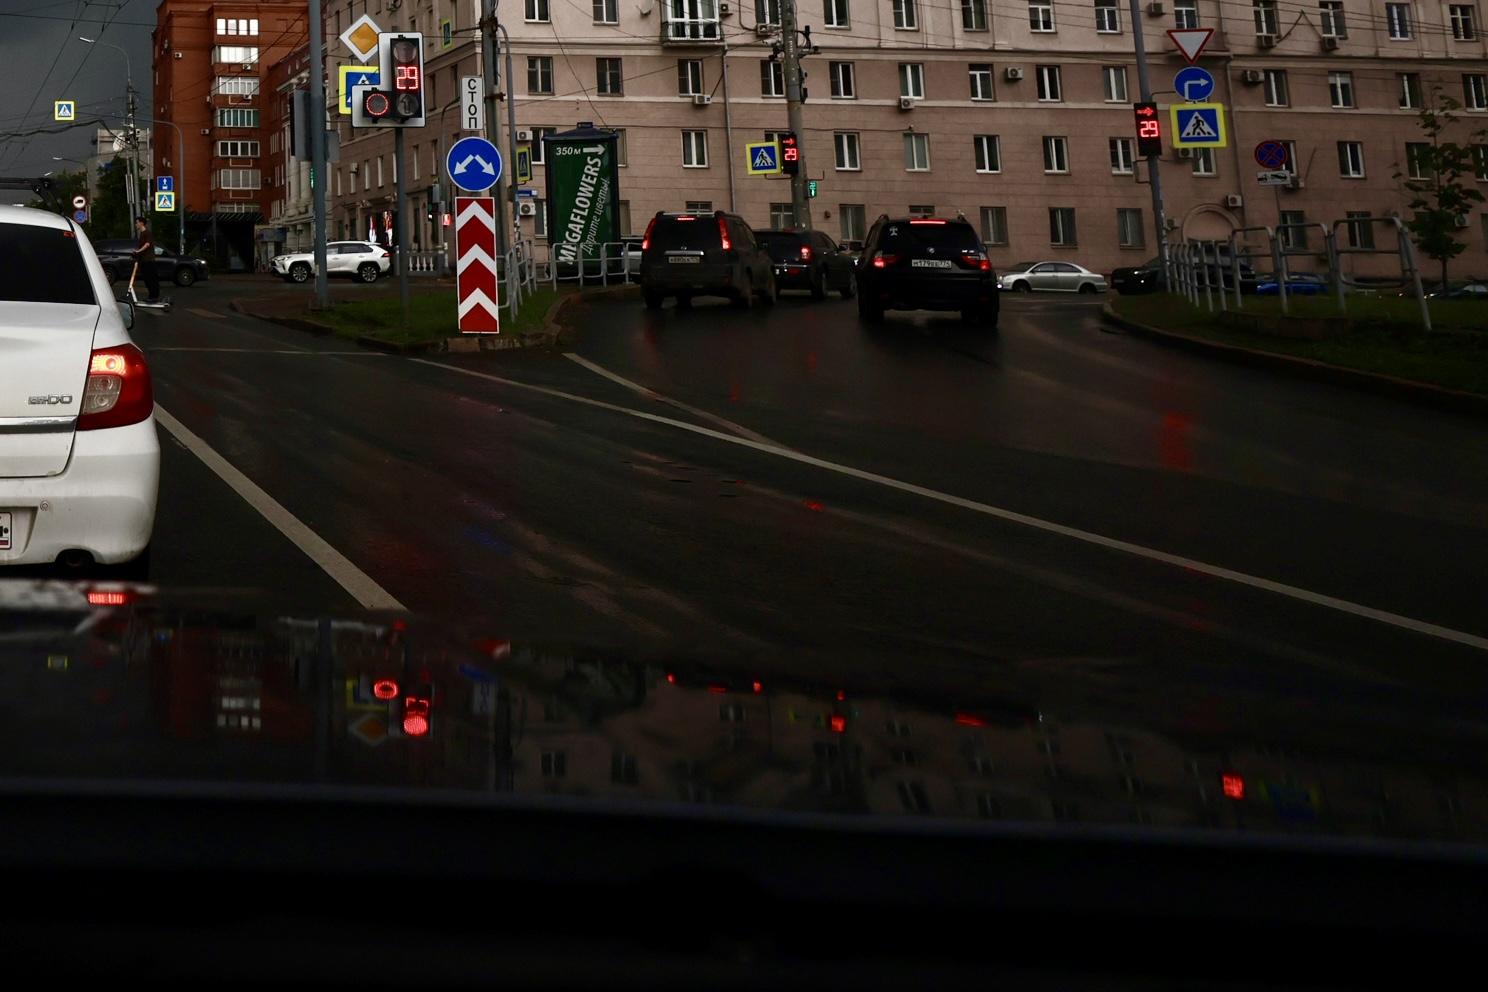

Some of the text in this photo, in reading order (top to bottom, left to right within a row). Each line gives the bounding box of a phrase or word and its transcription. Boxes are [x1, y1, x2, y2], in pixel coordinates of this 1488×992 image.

[396, 66, 419, 90] 29
[467, 78, 479, 129] СТОП
[1140, 120, 1160, 138] 29
[558, 156, 602, 265] MEGAFLOWERS
